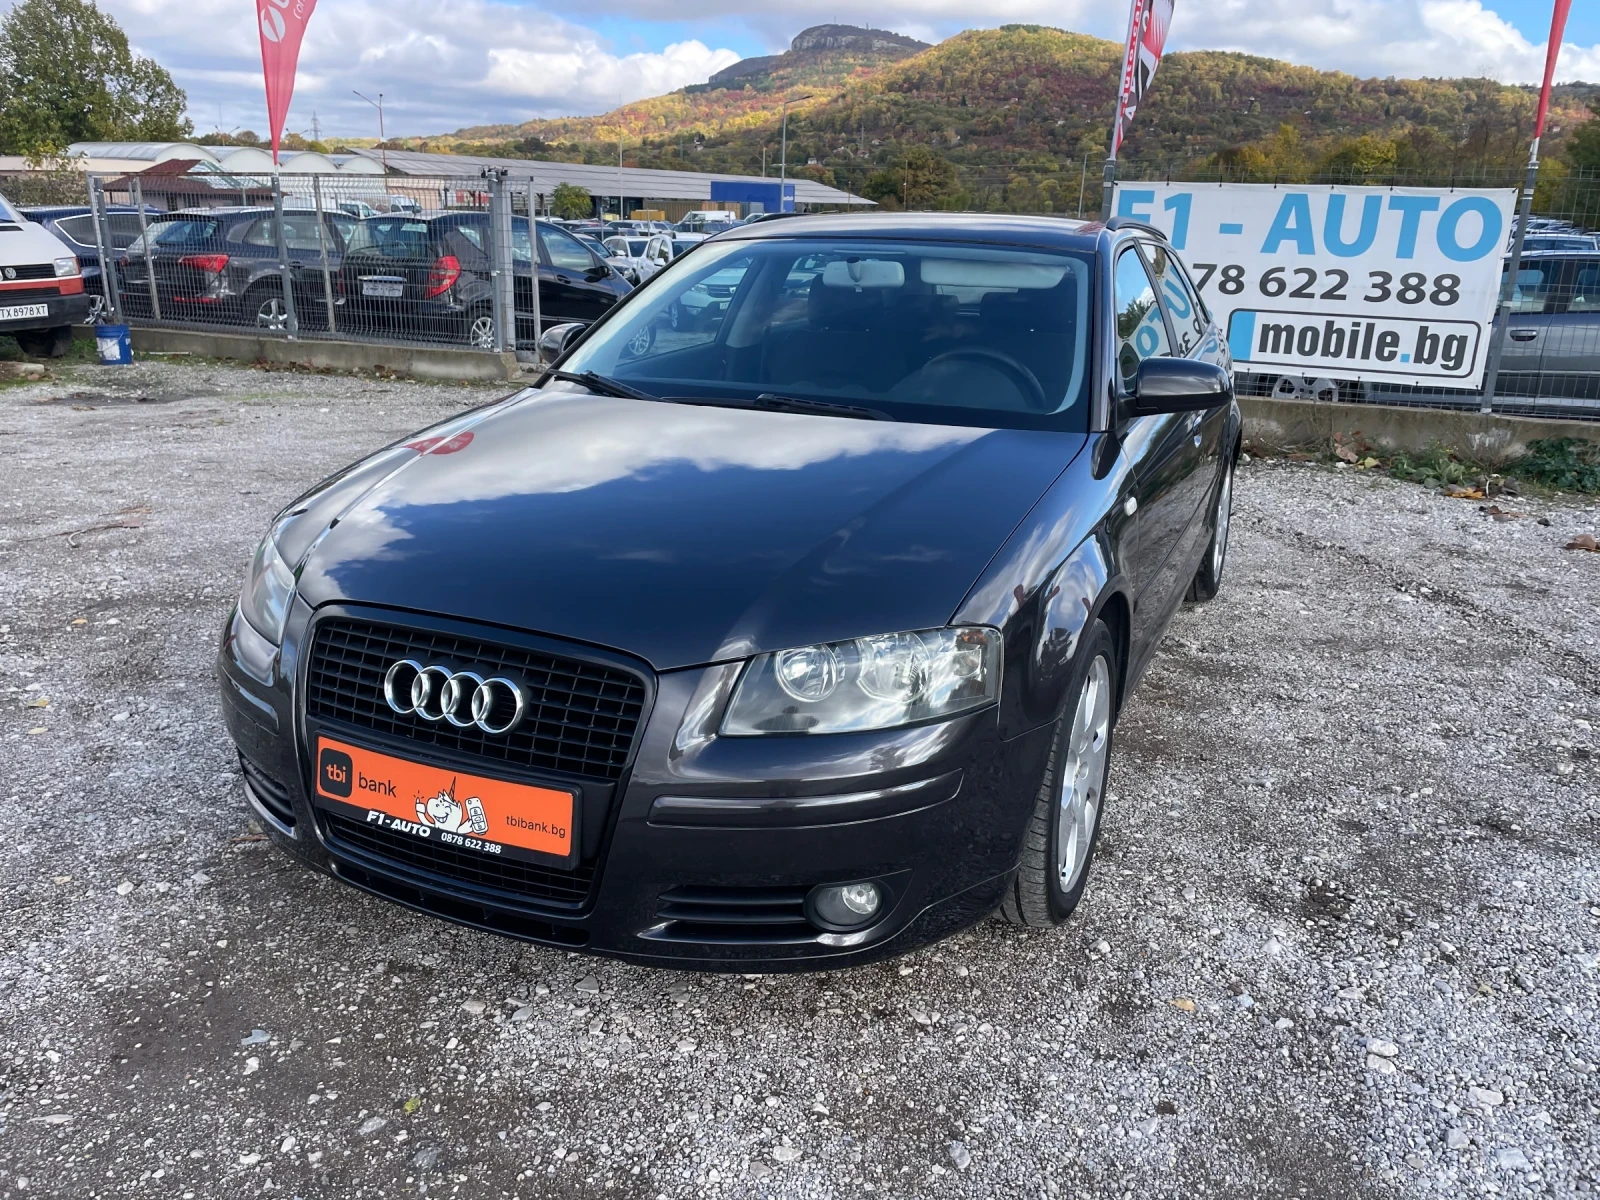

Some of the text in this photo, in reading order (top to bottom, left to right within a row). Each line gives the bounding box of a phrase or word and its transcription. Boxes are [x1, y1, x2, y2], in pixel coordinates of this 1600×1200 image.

[1259, 192, 1503, 262] AUTO
[1192, 262, 1462, 306] 78 622 388
[14, 307, 35, 317] 8978
[36, 306, 46, 316] XT
[1258, 320, 1469, 371] mobile.bg
[326, 763, 397, 799] tbi bank
[366, 810, 431, 838] F1-AUTO
[506, 815, 566, 839] tbibank.bg
[440, 832, 502, 854] 0878 622 388
